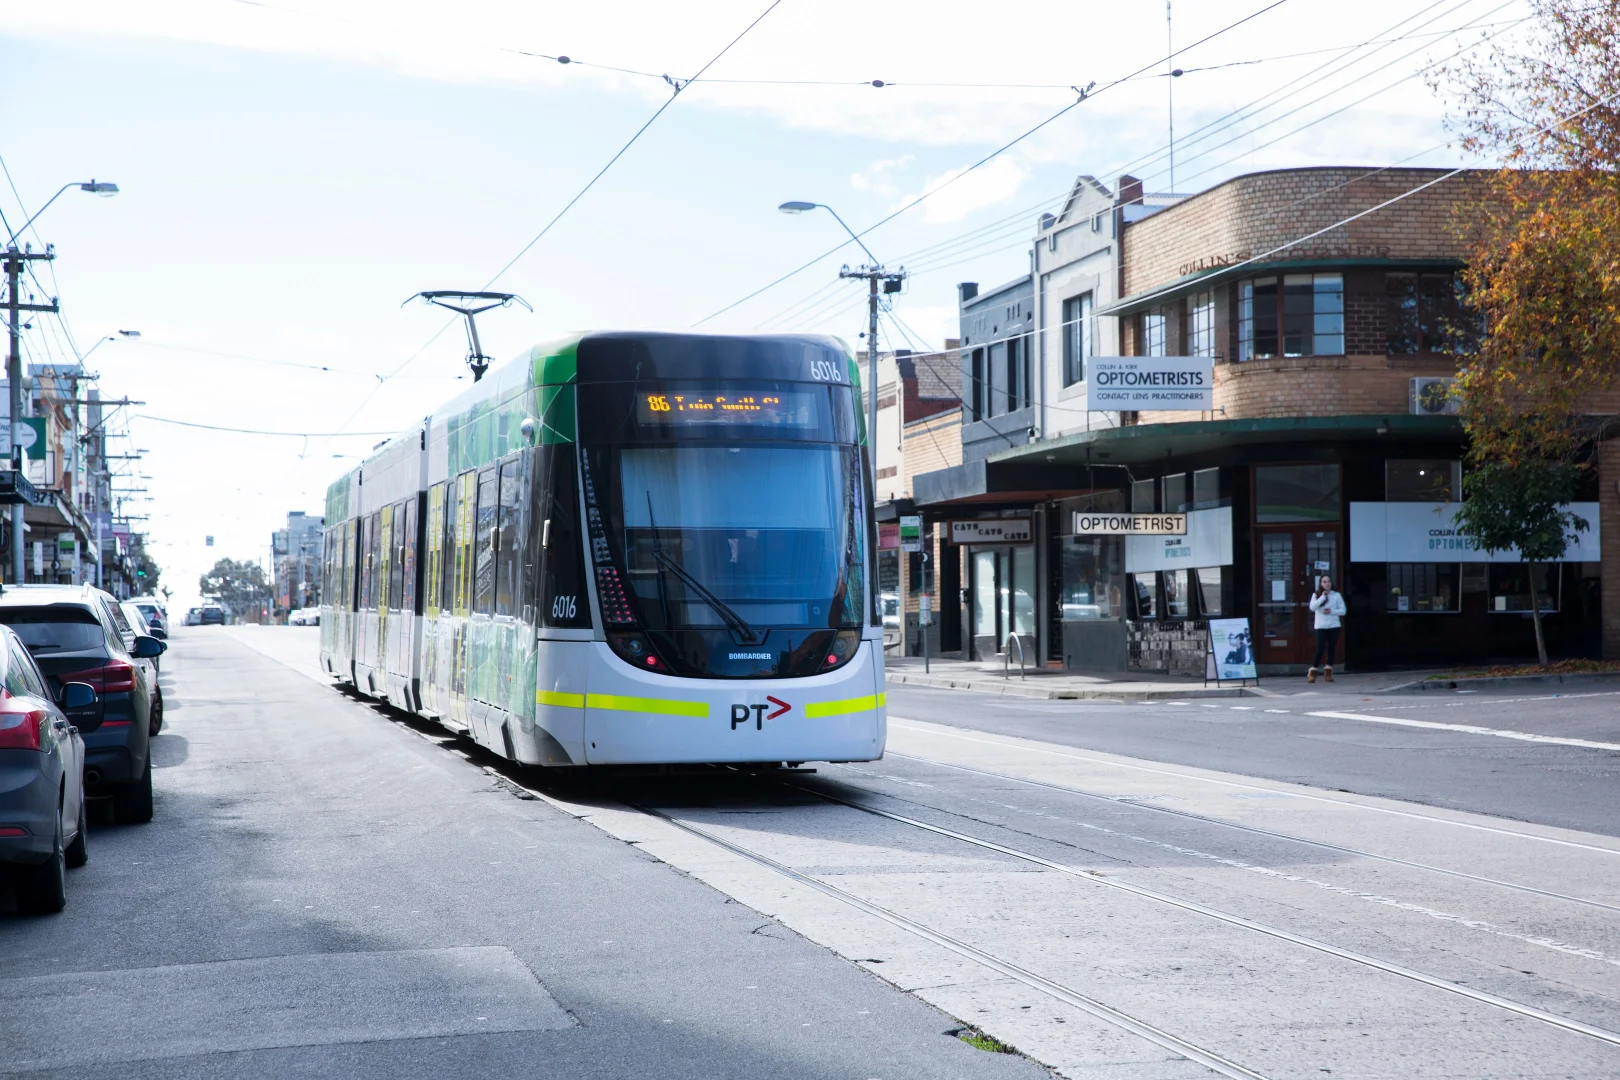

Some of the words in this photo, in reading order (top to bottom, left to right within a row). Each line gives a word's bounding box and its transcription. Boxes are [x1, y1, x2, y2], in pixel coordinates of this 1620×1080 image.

[810, 361, 841, 382] 6016
[1096, 371, 1203, 386] OPTOMETRISTS
[647, 396, 671, 412] 86
[954, 523, 978, 531] CATS
[978, 528, 1003, 536] CATS
[1004, 532, 1029, 540] CATS
[1080, 516, 1183, 531] OPTOMETRIST
[552, 595, 577, 619] 6016
[728, 652, 772, 660] BOMBARDIER
